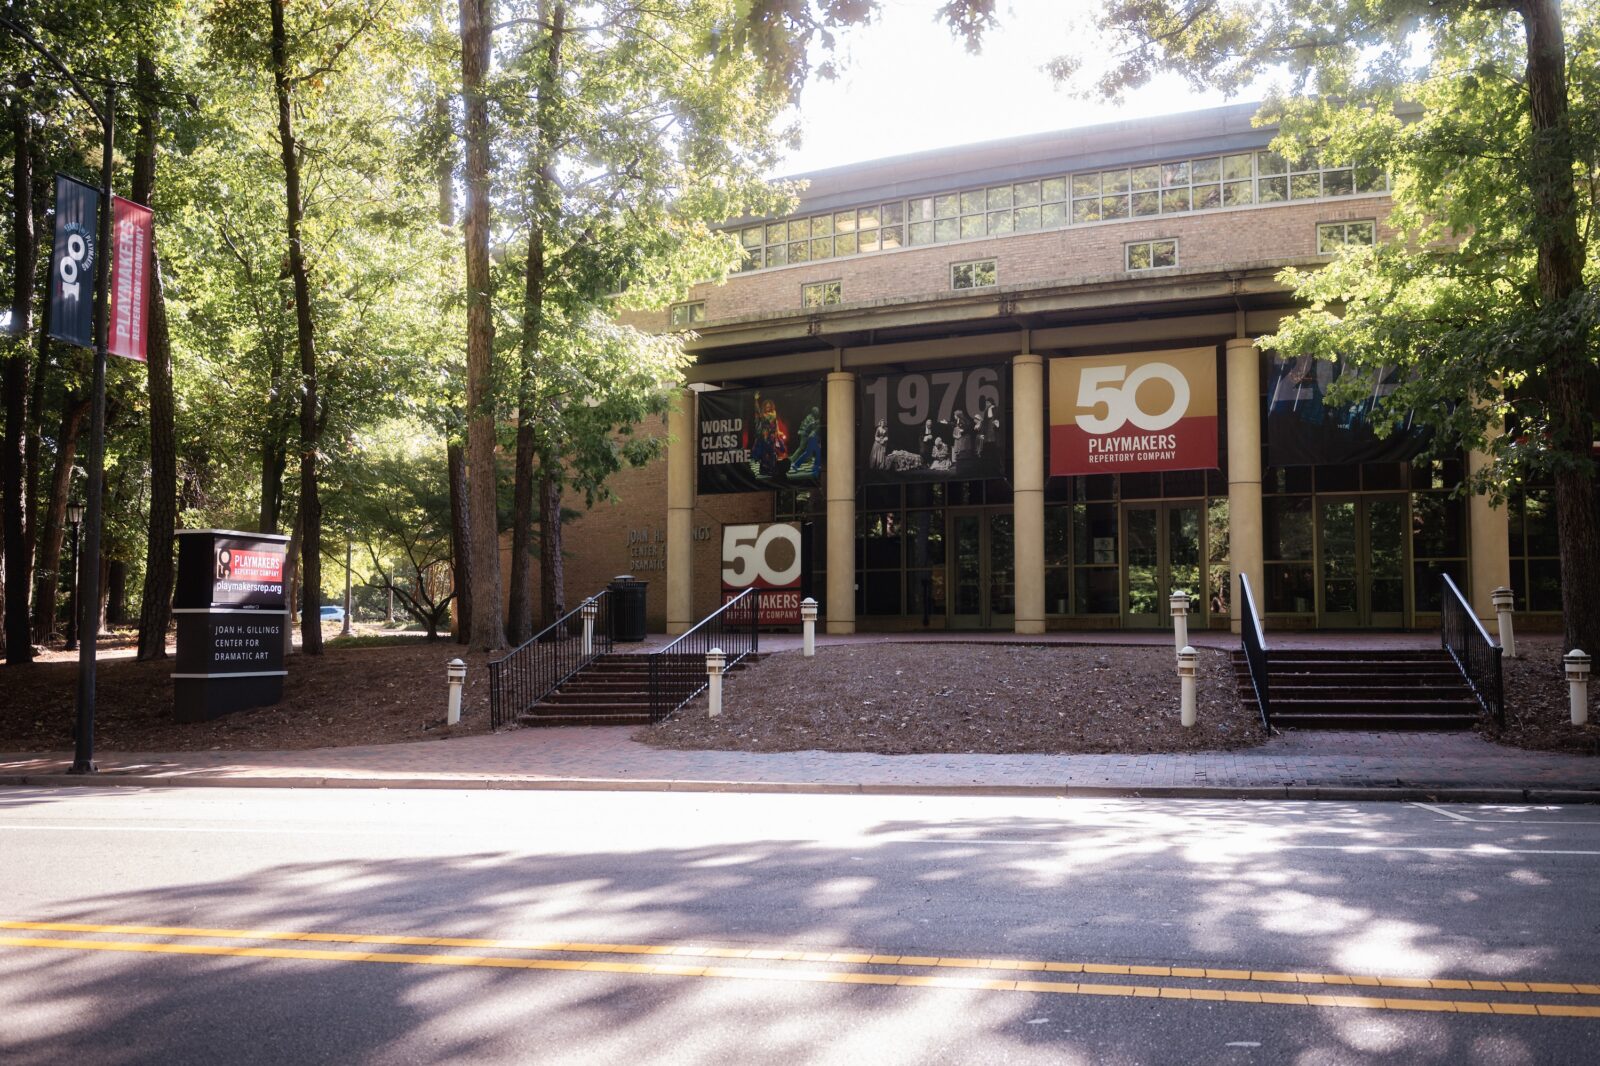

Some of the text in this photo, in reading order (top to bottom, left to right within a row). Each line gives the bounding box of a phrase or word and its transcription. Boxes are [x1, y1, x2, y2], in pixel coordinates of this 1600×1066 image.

[60, 234, 85, 301] 100
[117, 220, 134, 337] PLAYMAKERS
[132, 225, 144, 341] REPERTORY COMPANY
[866, 367, 1000, 426] 1976
[1075, 362, 1190, 435] 50
[701, 418, 742, 433] WORLD
[701, 434, 738, 449] CLASS
[1088, 434, 1177, 453] PLAYMAKERS
[701, 450, 751, 465] THEATRE
[1088, 450, 1177, 464] REPERTORY COMPANY
[631, 545, 657, 558] CENTER
[722, 523, 801, 587] 50
[234, 555, 279, 569] PLAYMAKERS
[631, 559, 665, 571] DRAMATIC
[260, 569, 279, 577] COMPANY
[216, 581, 282, 594] playmakersrep.org
[766, 610, 798, 619] COMPANY
[215, 626, 279, 636] JOAN H. GILLINGS
[215, 639, 260, 647] CENTER FOR
[215, 652, 269, 661] DRAMATIC ART
